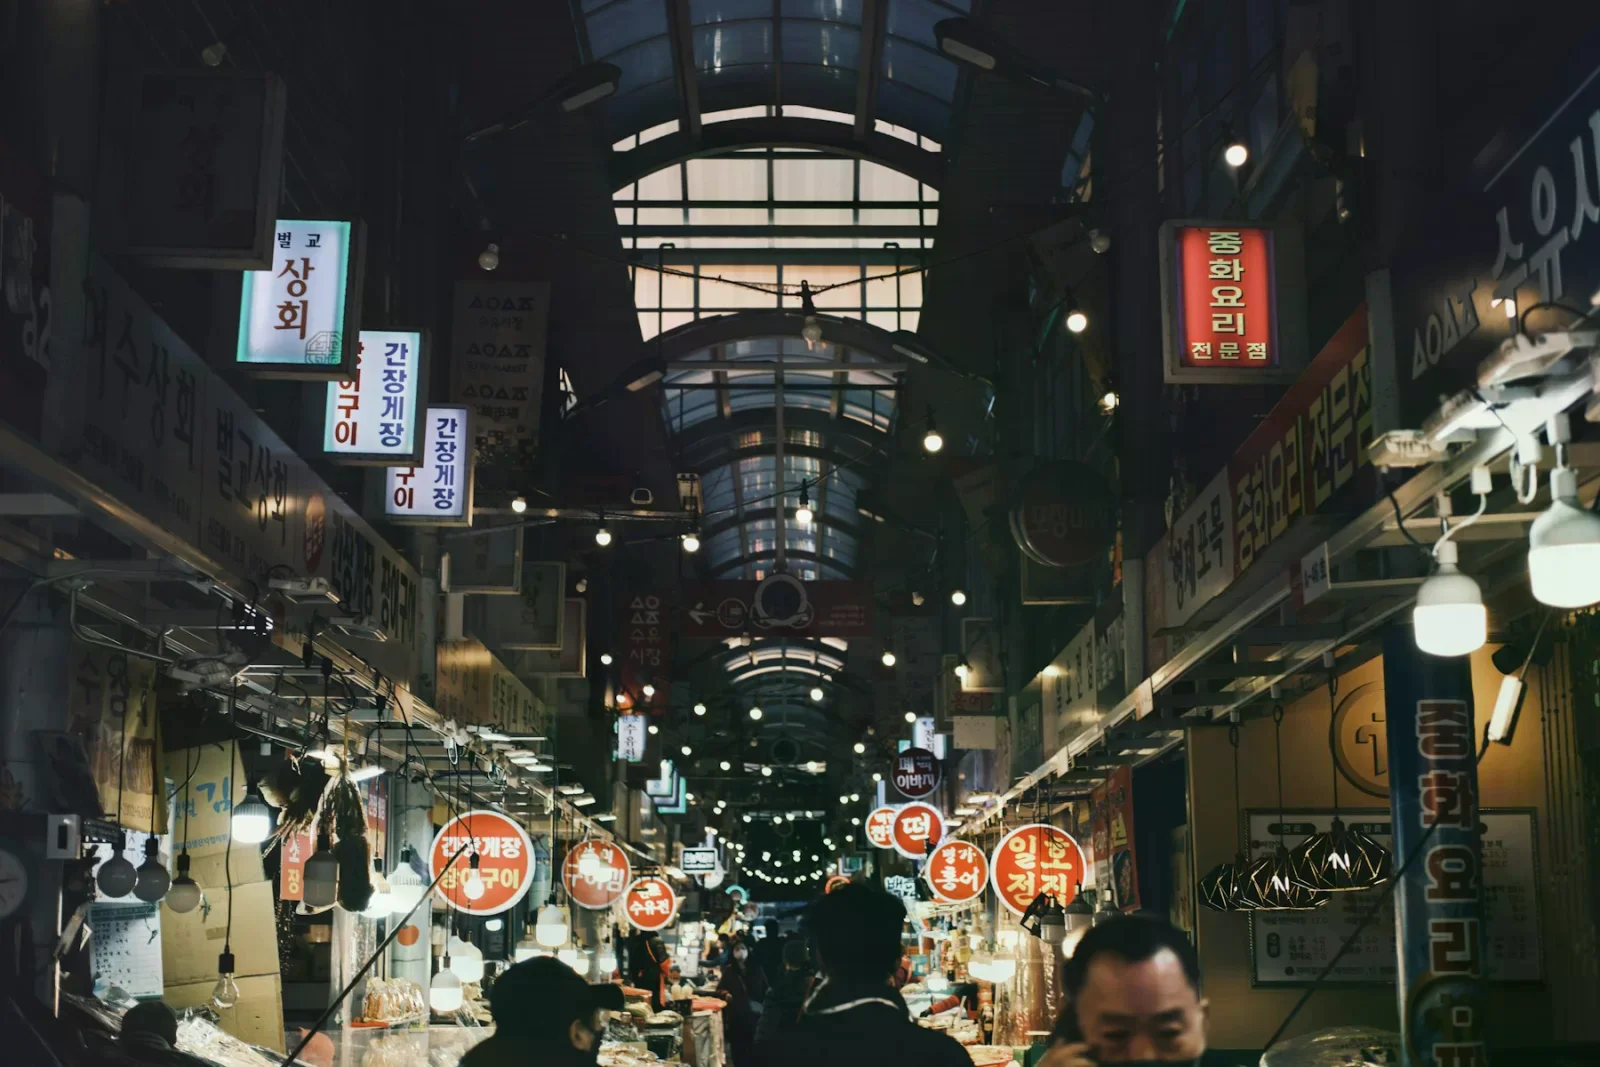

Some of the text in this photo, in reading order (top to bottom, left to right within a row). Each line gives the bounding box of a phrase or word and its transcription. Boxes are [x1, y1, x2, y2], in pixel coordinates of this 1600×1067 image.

[277, 231, 321, 249] 벌교
[273, 256, 315, 340] 상회
[1207, 231, 1246, 336] 중화요리
[1190, 341, 1268, 361] 전문점
[378, 342, 409, 447] 간장게장
[216, 407, 288, 547] 벌교상회
[433, 418, 458, 510] 간장게장
[1236, 414, 1307, 571] 중화요리
[441, 836, 522, 859] 간장게장
[901, 812, 931, 848] 떡
[941, 847, 977, 866] 명가
[1008, 834, 1072, 870] 일호
[934, 865, 980, 892] 홍어
